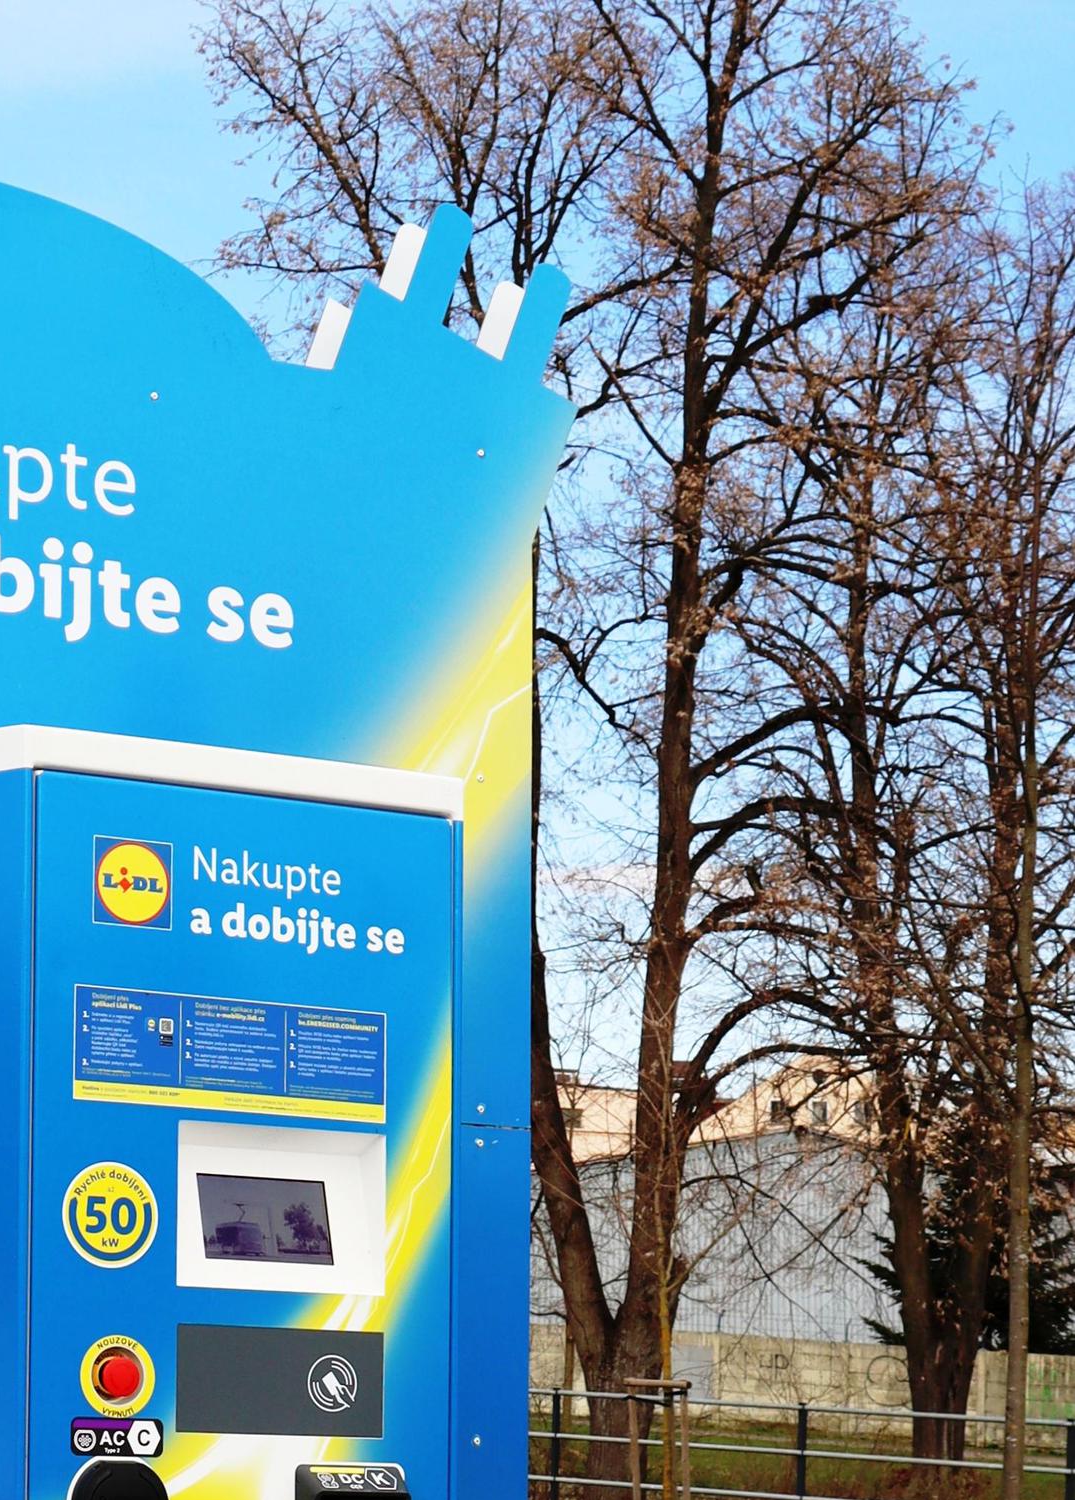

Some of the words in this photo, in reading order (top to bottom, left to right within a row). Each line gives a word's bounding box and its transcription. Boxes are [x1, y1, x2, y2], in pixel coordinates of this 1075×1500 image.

[206, 586, 294, 649] se
[193, 845, 341, 900] Nakupte
[189, 907, 212, 935] a
[221, 902, 357, 955] dobijte
[366, 925, 405, 955] se
[73, 1170, 106, 1196] Rychlé
[85, 1195, 137, 1235] 50
[101, 1237, 119, 1247] kW
[99, 1430, 125, 1447] AC
[137, 1429, 150, 1447] C
[337, 1473, 364, 1484] DC
[370, 1471, 391, 1486] K
